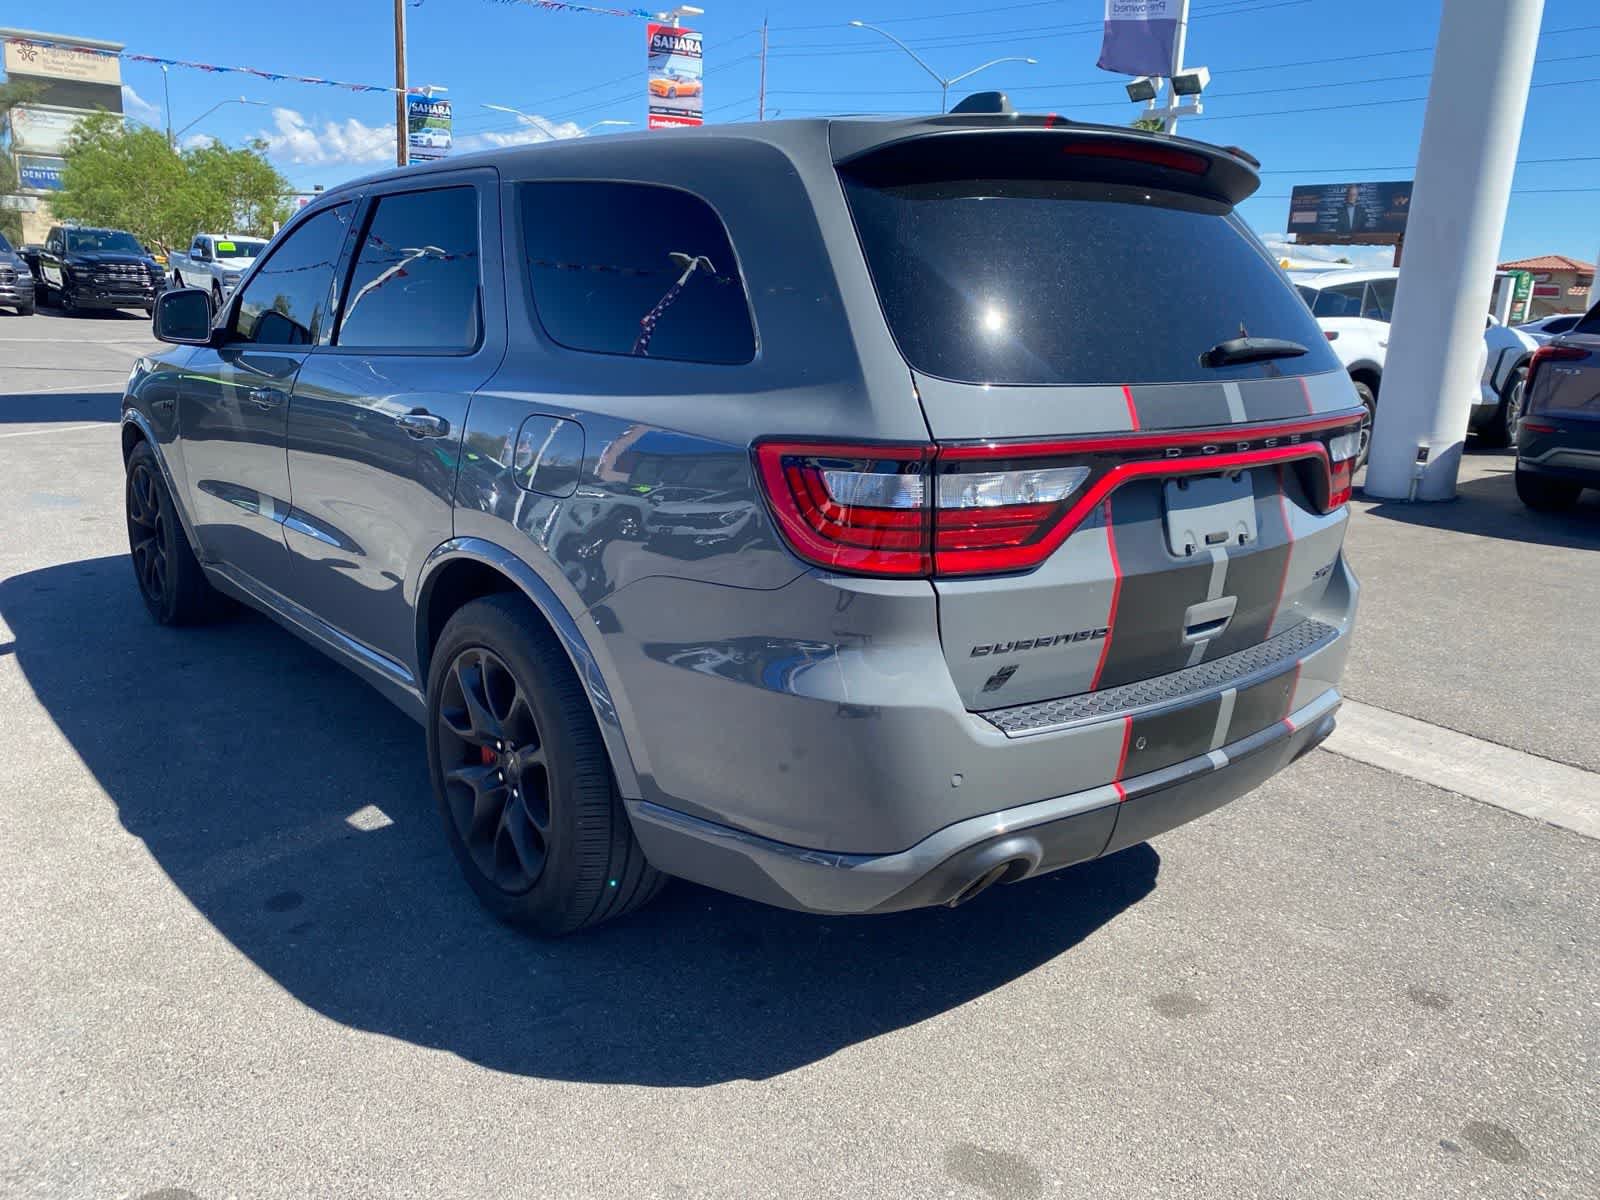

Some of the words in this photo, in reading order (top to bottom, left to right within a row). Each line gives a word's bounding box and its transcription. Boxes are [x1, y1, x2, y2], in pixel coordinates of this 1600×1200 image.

[653, 34, 702, 53] SAHARA
[411, 102, 451, 115] SAHARA
[1165, 434, 1301, 457] DODGE
[970, 626, 1109, 658] DURANGO
